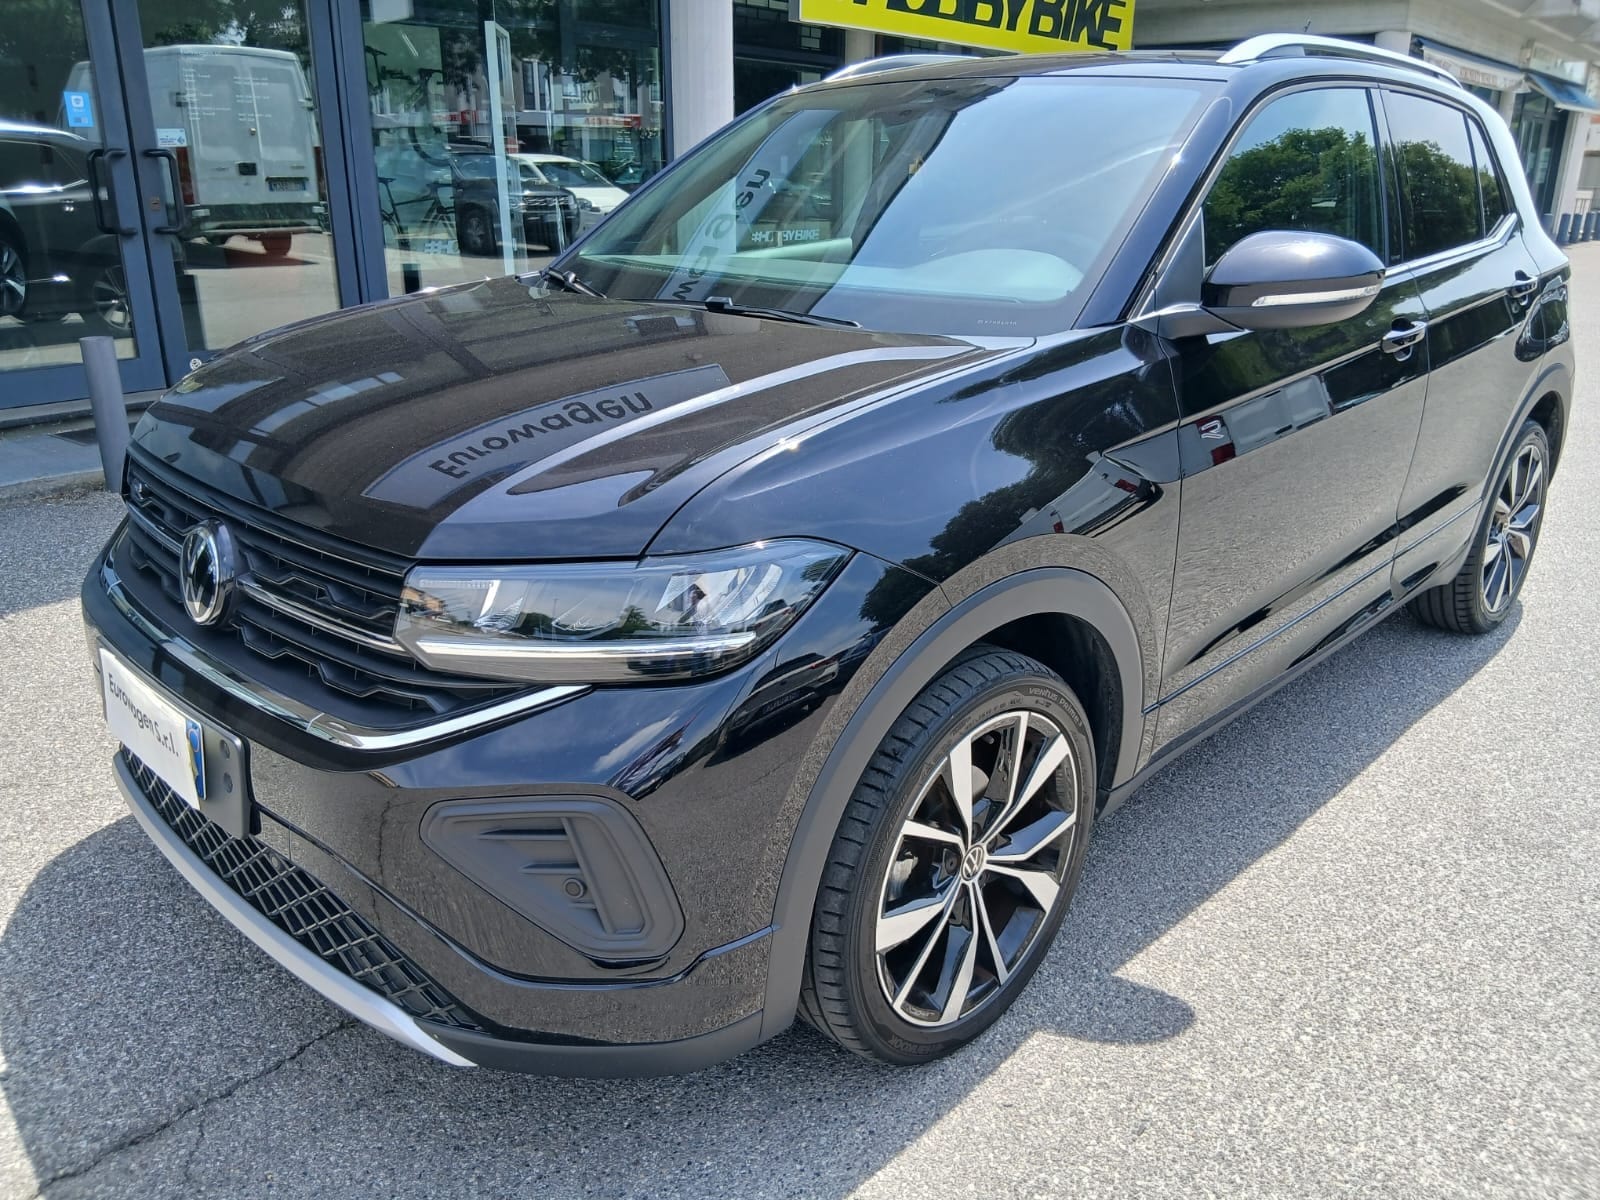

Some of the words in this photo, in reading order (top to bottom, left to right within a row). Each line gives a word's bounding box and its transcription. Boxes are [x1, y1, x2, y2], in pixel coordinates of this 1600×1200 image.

[853, 0, 1126, 51] BYBIKE
[751, 228, 820, 243] #HOBYBIKE
[108, 672, 155, 737] Eurowagen
[155, 723, 180, 757] S.r.l.
